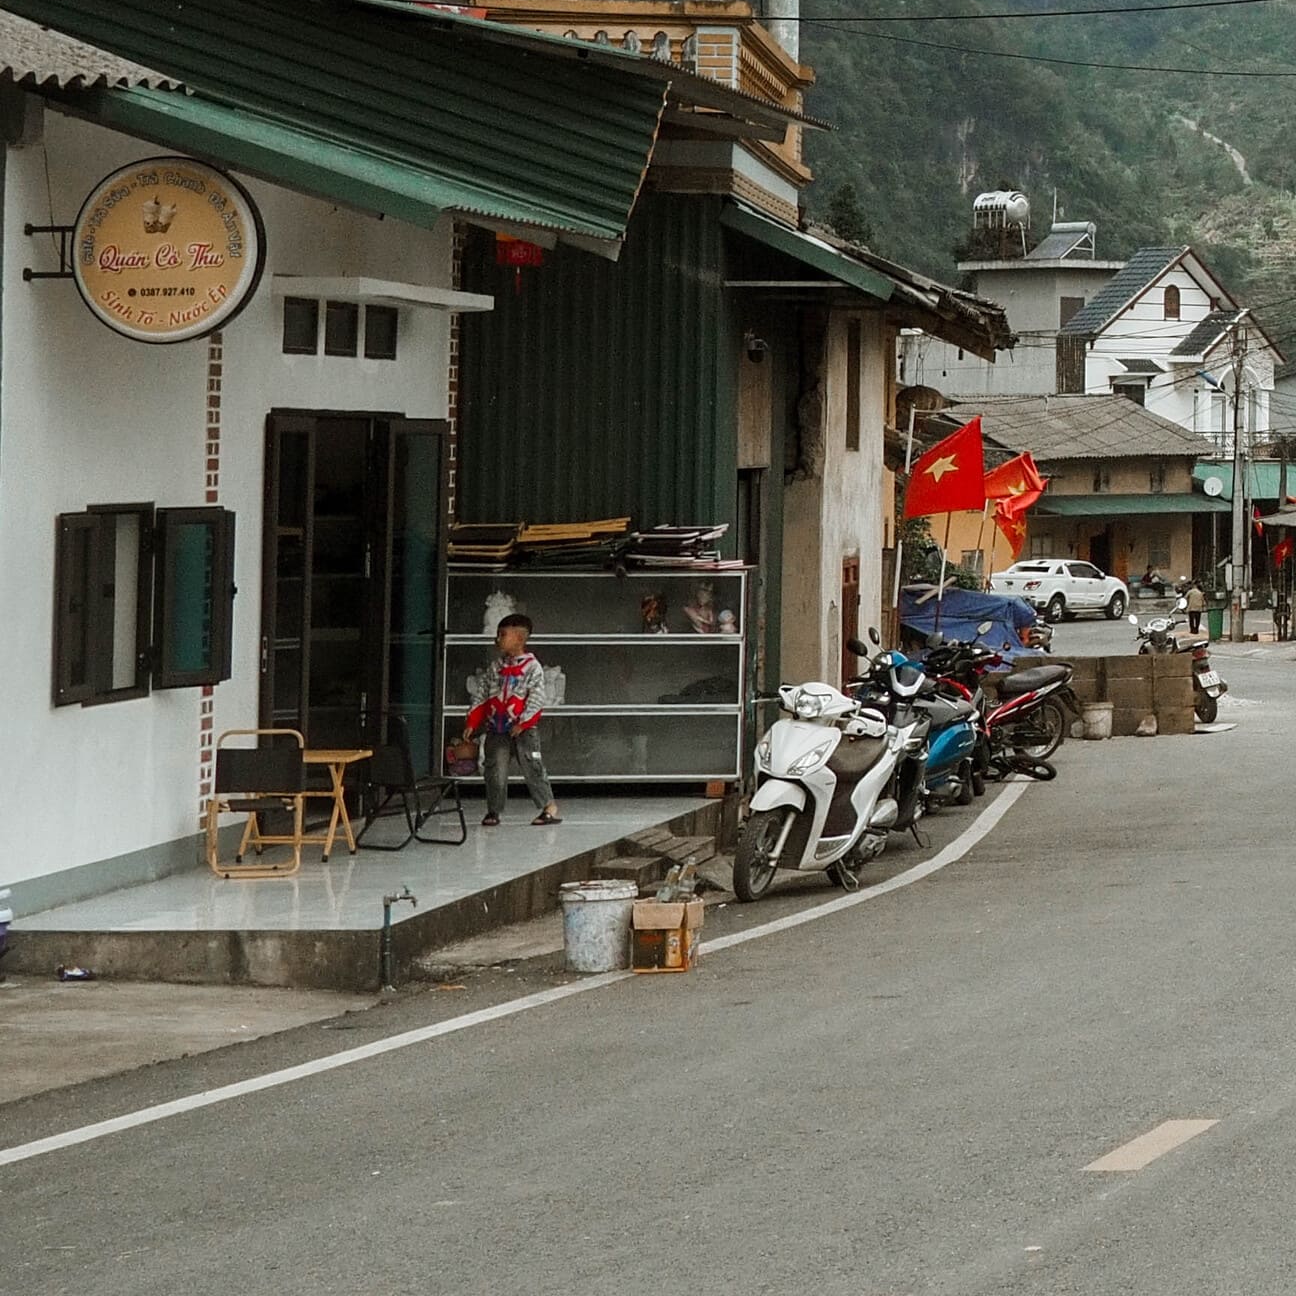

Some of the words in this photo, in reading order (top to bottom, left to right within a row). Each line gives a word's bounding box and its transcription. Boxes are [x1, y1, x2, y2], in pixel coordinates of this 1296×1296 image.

[98, 244, 148, 272] Quán
[188, 242, 223, 270] Thu
[101, 290, 133, 319] Sinh
[136, 310, 157, 325] Tố
[169, 301, 210, 326] Nước
[208, 284, 228, 304] Ép
[140, 287, 195, 297] 0387.927.410
